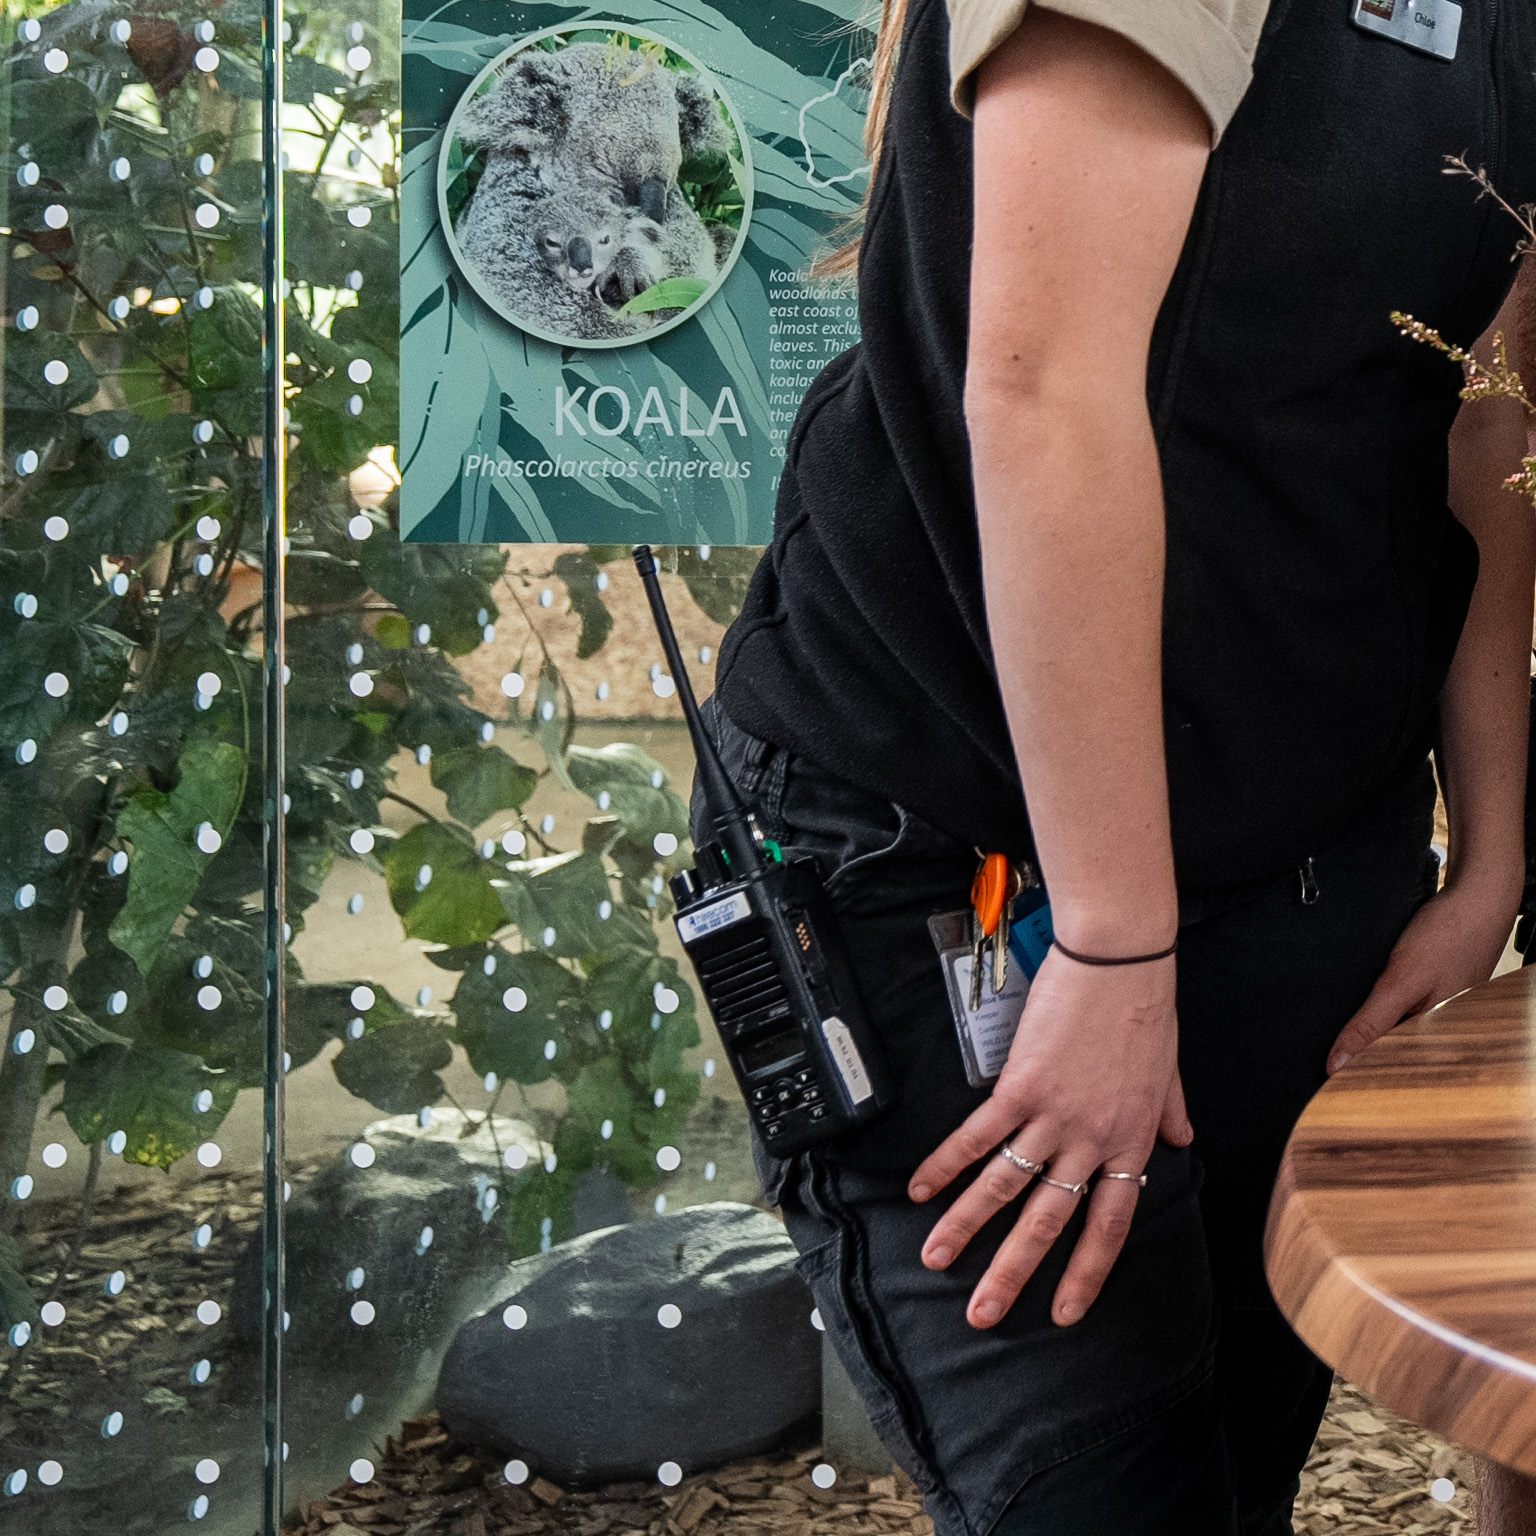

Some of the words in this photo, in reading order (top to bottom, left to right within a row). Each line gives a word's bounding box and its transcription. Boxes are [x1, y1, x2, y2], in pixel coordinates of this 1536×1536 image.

[1414, 12, 1437, 30] Chloe
[769, 285, 848, 300] woodlands
[768, 305, 800, 318] east
[802, 305, 842, 318] coast
[768, 321, 819, 335] almost
[768, 338, 818, 353] leaves.
[823, 338, 852, 353] This
[769, 356, 804, 370] toxic
[555, 385, 749, 438] KOALA
[464, 453, 639, 478] Phascolarctos
[645, 454, 752, 479] cinereus
